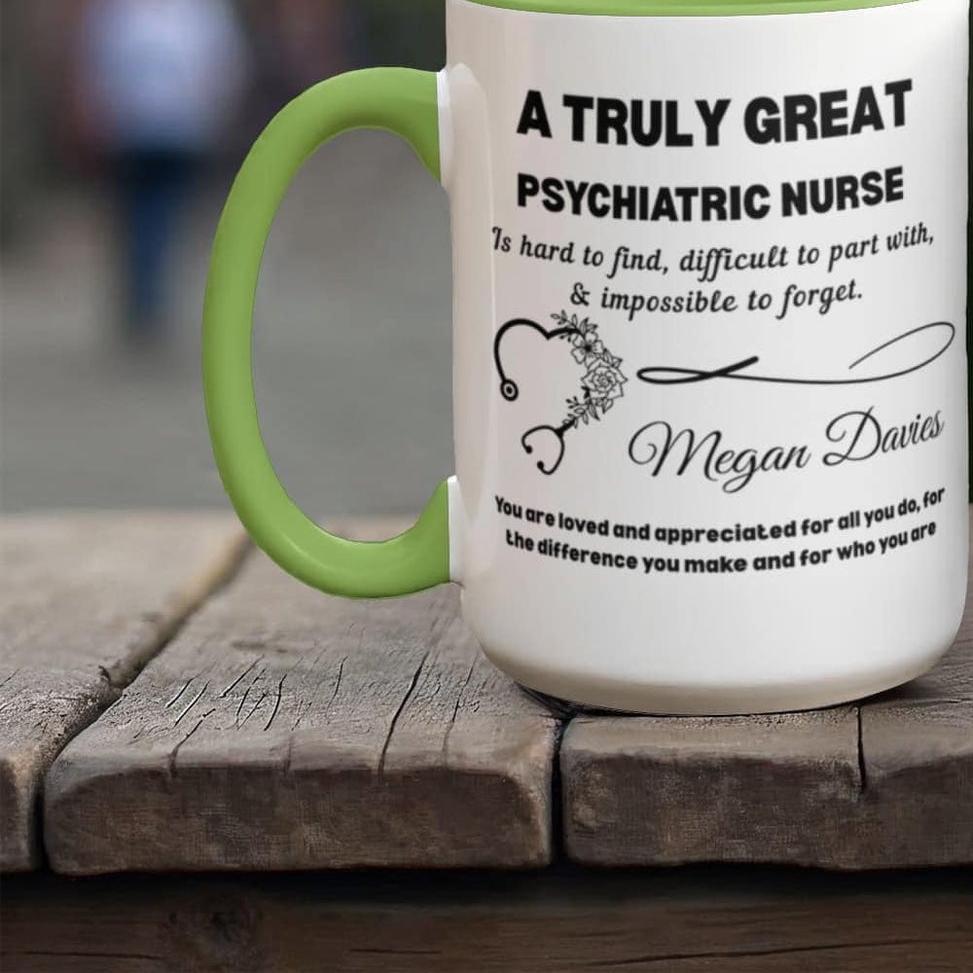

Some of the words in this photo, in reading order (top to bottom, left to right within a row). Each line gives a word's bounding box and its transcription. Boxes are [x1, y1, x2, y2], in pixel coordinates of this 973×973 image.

[515, 89, 552, 139] A
[561, 93, 732, 147] TRULY
[743, 77, 913, 145] GREAT
[516, 171, 771, 222] PSYCHIATRIC
[780, 165, 903, 217] NURSE
[491, 225, 511, 252] Is
[519, 233, 575, 264] hard
[582, 245, 604, 267] to
[605, 245, 668, 279] find,
[678, 244, 788, 283] difficult
[796, 244, 820, 265] to
[826, 233, 879, 273] part
[885, 221, 933, 251] with,
[569, 281, 590, 307] &
[600, 286, 738, 321] impossible
[747, 289, 772, 311] to
[775, 278, 862, 320] forget.
[627, 420, 811, 494] Megan
[821, 405, 944, 466] Davies
[494, 494, 522, 519] You
[524, 507, 555, 527] are
[557, 511, 609, 537] loved
[612, 522, 650, 541] and
[653, 519, 797, 545] appreciated
[800, 517, 834, 536] for
[836, 509, 860, 530] all
[863, 504, 895, 528] you
[896, 497, 921, 516] do,
[922, 487, 945, 508] for
[505, 528, 534, 551] the
[536, 537, 638, 569] difference
[641, 556, 680, 574] you
[683, 555, 748, 573] make
[751, 550, 795, 571] and
[798, 547, 833, 566] for
[835, 539, 875, 560] who
[877, 530, 908, 555] you
[910, 521, 936, 542] are
